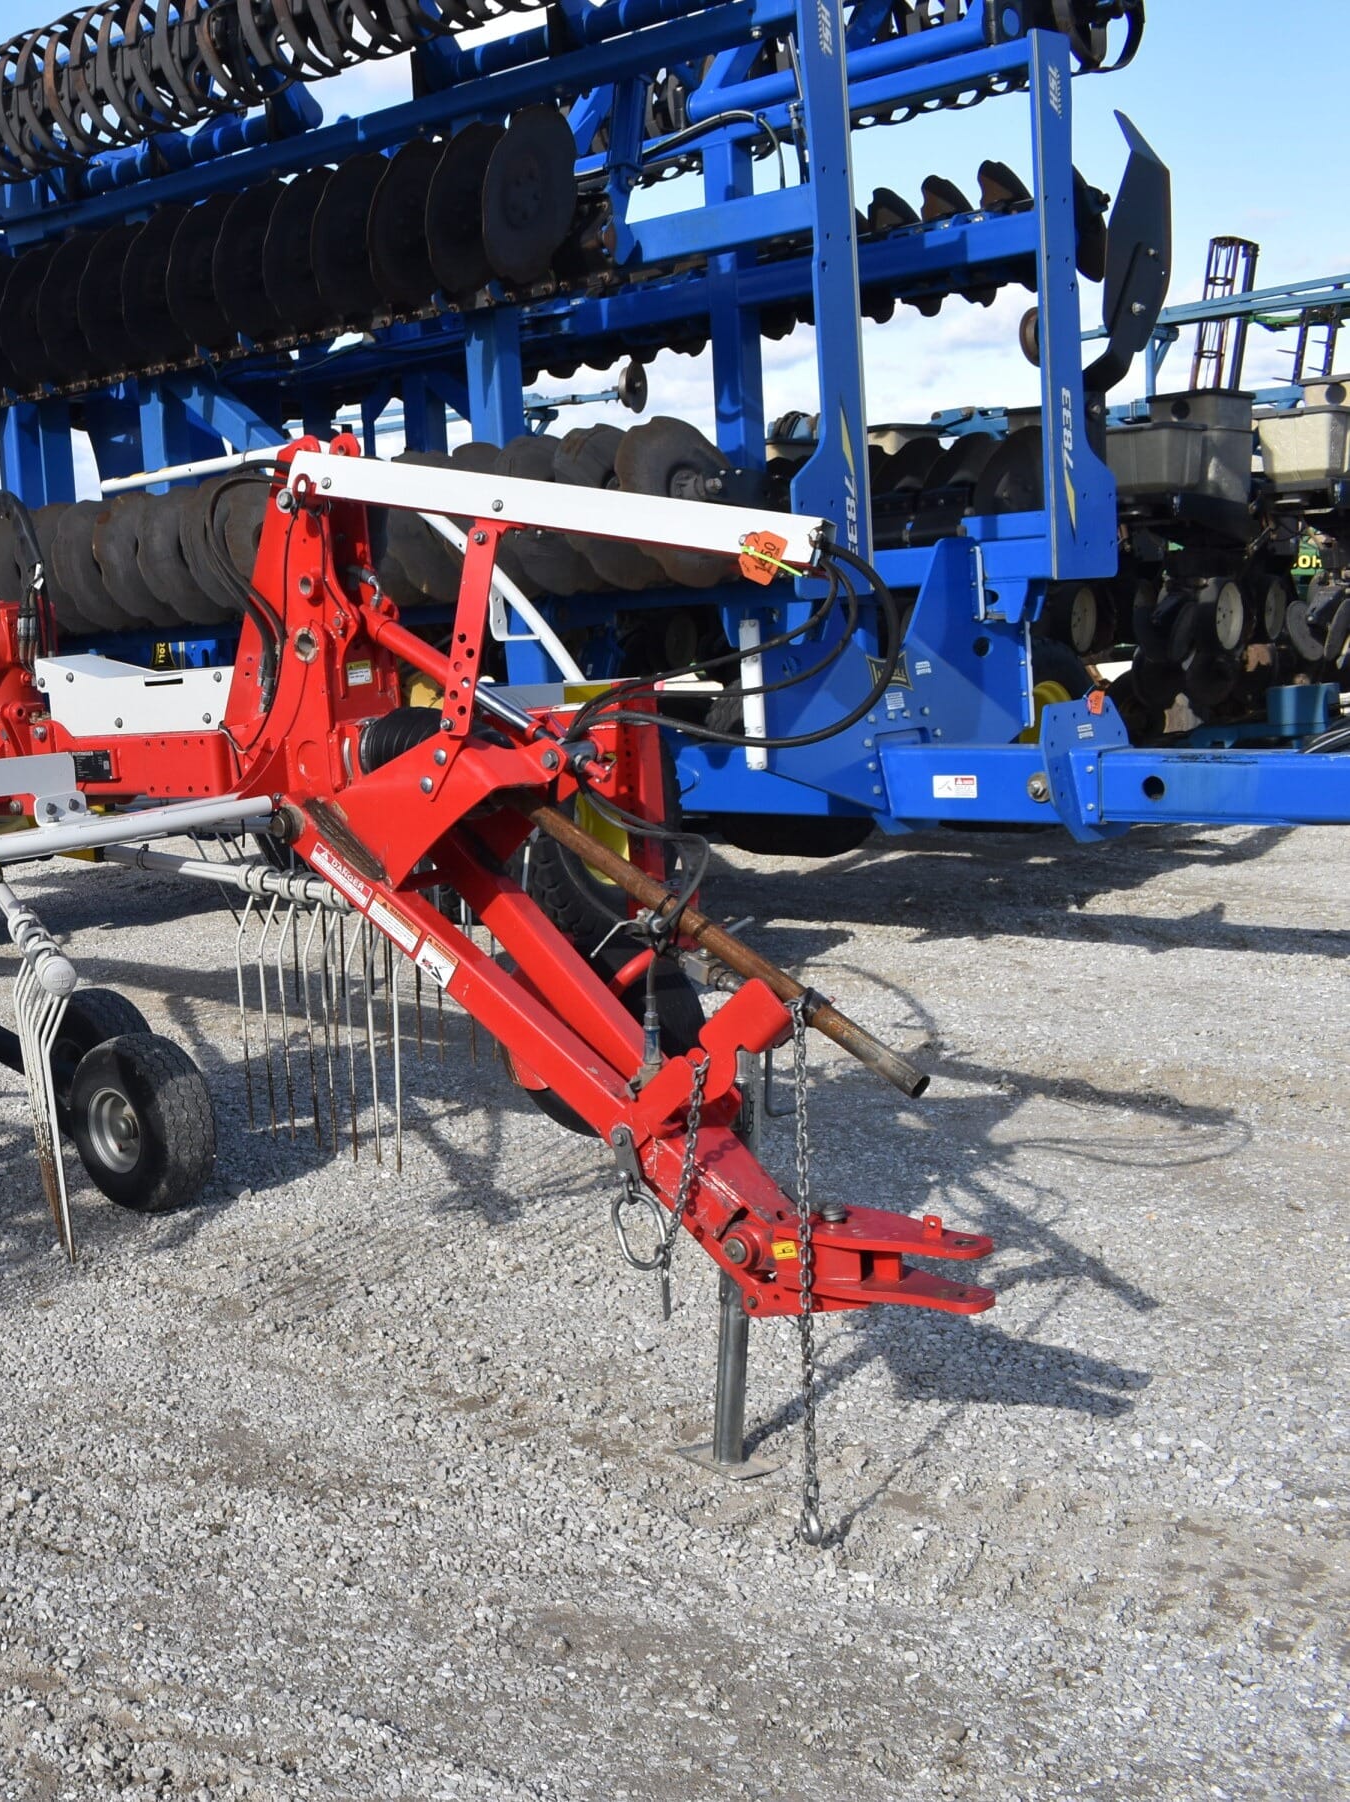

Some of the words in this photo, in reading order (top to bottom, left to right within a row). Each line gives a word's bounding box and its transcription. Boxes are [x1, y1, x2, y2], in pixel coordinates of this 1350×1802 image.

[1061, 387, 1074, 470] 7833
[331, 857, 365, 891] DANGER
[389, 904, 414, 931] WARNING
[433, 941, 456, 963] WARNING
